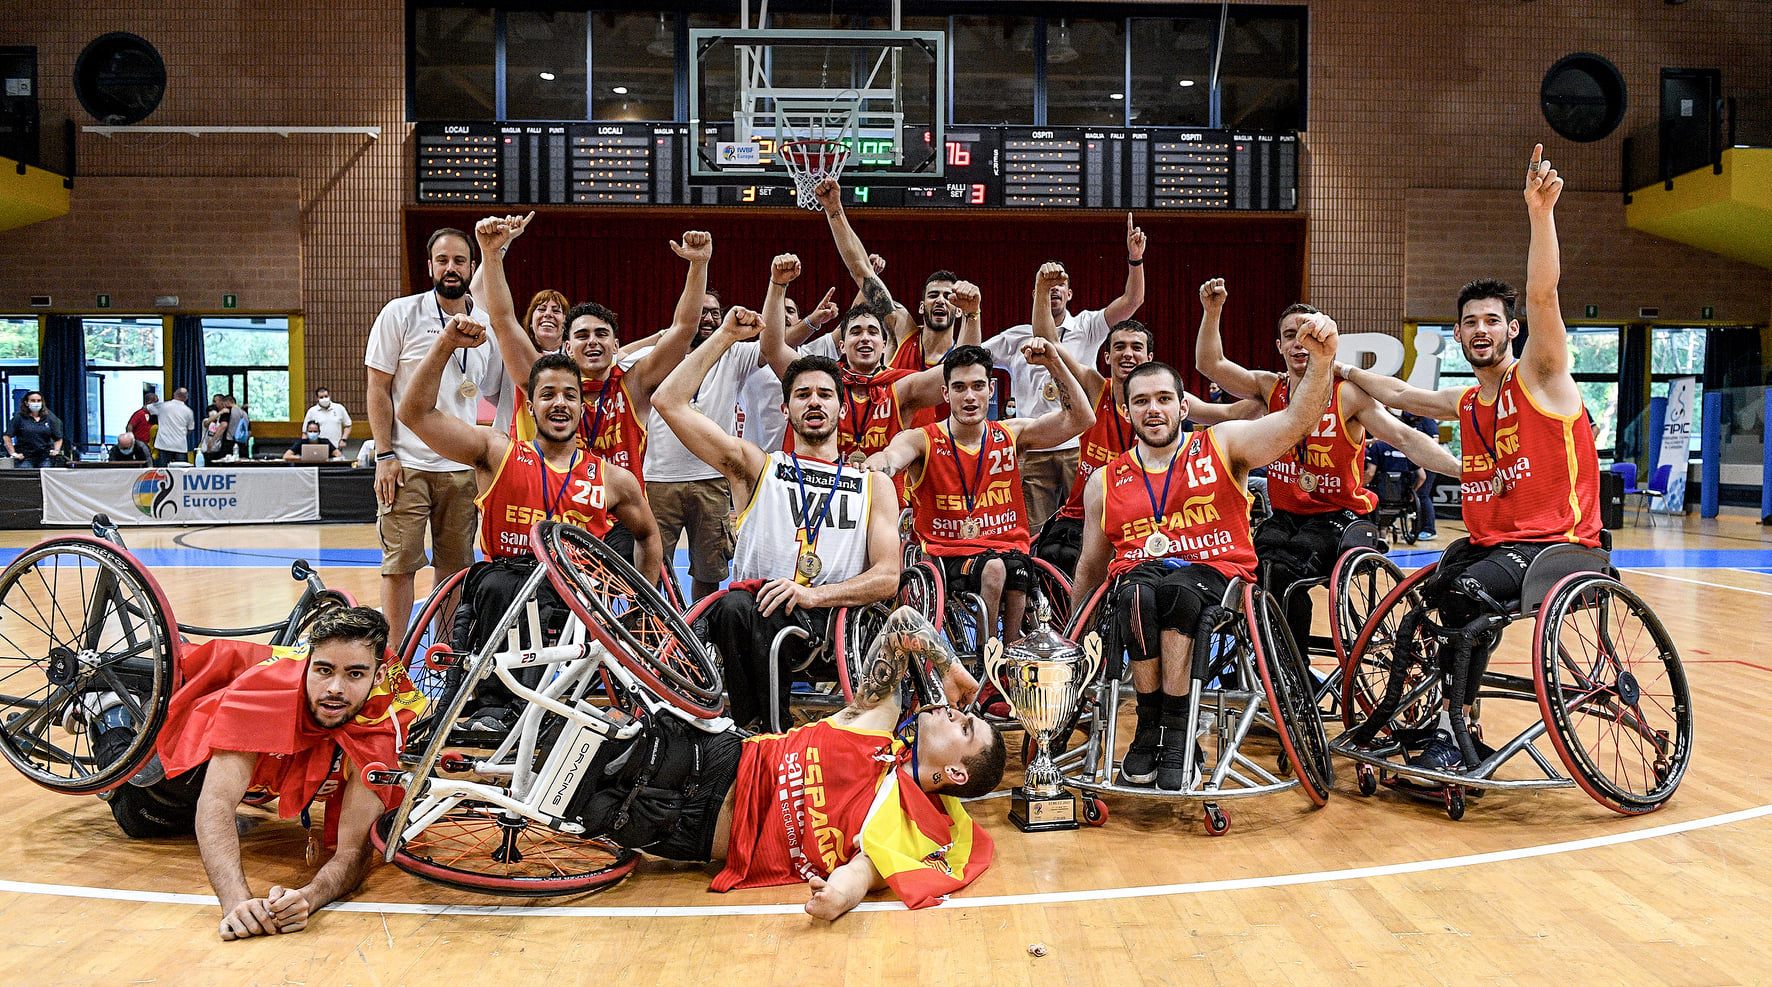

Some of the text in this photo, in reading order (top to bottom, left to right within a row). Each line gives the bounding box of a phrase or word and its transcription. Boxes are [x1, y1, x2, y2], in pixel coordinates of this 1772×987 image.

[444, 126, 470, 134] LOCALI
[598, 127, 623, 135] LOCALI
[1031, 131, 1054, 139] OSPITI
[1181, 133, 1202, 141] OSPITI
[945, 142, 972, 166] 76
[759, 188, 772, 196] SET
[946, 183, 966, 191] FALLI
[951, 190, 964, 198] SET
[971, 184, 986, 205] 3
[987, 445, 1015, 476] 23
[796, 470, 858, 490] CaixaBank
[1185, 455, 1218, 489] 13
[183, 474, 237, 491] IWBF
[1114, 474, 1135, 488] vive
[183, 495, 237, 510] Europe
[571, 479, 606, 510] 20
[786, 486, 857, 530] VAL
[804, 746, 852, 874] ESPAÑA
[780, 801, 799, 847] SEGUROS
